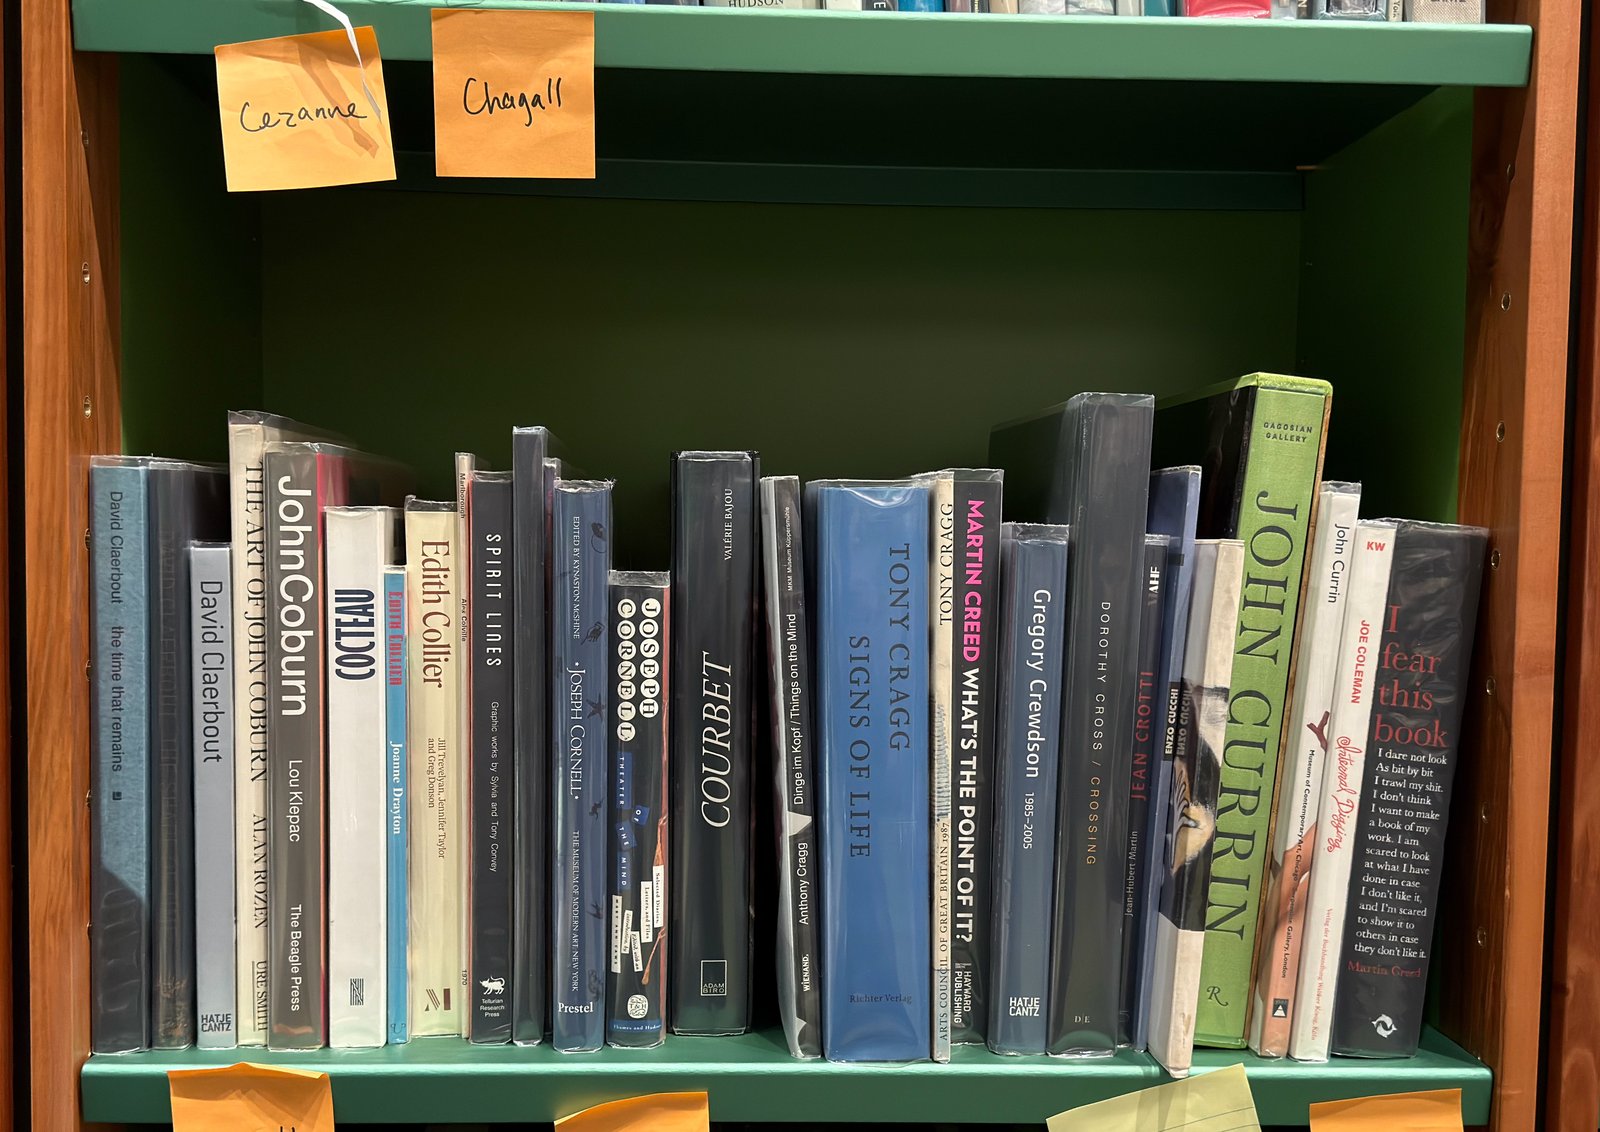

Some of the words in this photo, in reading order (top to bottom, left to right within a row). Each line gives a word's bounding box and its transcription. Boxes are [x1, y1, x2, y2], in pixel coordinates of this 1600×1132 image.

[239, 102, 368, 132] Cezanne
[464, 77, 562, 127] Chagall
[1263, 422, 1313, 434] GAGOSIAN
[1265, 432, 1307, 443] GALLERY
[245, 462, 265, 514] THE
[459, 473, 467, 518] Marlborough
[724, 488, 734, 519] BAJOU
[110, 491, 123, 530] David
[246, 520, 265, 573] ART
[723, 522, 733, 560] VALÉRIE
[940, 503, 952, 567] CRAGG
[964, 500, 985, 585] MARTIN
[1334, 523, 1350, 554] John
[1367, 541, 1386, 551] KW
[110, 535, 123, 604] Claerbout
[486, 534, 502, 599] SPIRIT
[573, 548, 580, 559] BY
[422, 540, 451, 605] Edith
[786, 576, 794, 591] MKM
[889, 543, 910, 631] TONY
[1236, 490, 1299, 665] JOHN
[1327, 560, 1345, 604] Currin
[247, 578, 265, 610] OF
[939, 573, 952, 626] TONY
[200, 581, 224, 644] David
[786, 614, 796, 641] Mind
[963, 591, 982, 662] CREED
[1026, 589, 1052, 671] Gregory
[1385, 605, 1401, 633] I
[110, 626, 124, 650] the
[244, 611, 265, 676] JOHN
[335, 589, 375, 680] COCTEAU
[1096, 602, 1111, 682] DOROTHY
[1359, 619, 1370, 643] JOE
[422, 611, 451, 689] Collier
[641, 600, 659, 717] JOSEPH
[788, 644, 797, 661] the
[1381, 642, 1441, 674] fear
[110, 653, 124, 683] time
[619, 601, 634, 738] CORNELL
[790, 664, 799, 678] on
[849, 636, 870, 729] SIGNS
[1350, 646, 1367, 704] COLEMAN
[110, 686, 124, 711] that
[200, 652, 224, 763] Claerbout
[567, 668, 586, 721] JOSEPH
[789, 681, 801, 718] Things
[889, 643, 910, 752] CRAGG
[1136, 671, 1153, 742] CROTTI
[1168, 688, 1179, 723] CUCCHI
[1378, 679, 1433, 710] this
[248, 681, 267, 783] COBURN
[490, 701, 500, 732] Graphic
[1025, 679, 1047, 778] Crewdson
[1092, 694, 1106, 750] CROSS
[1375, 714, 1448, 748] book
[110, 717, 124, 772] remains
[428, 738, 436, 754] and
[437, 737, 446, 751] Jill
[491, 736, 499, 758] works
[701, 650, 732, 828] COURBET
[791, 727, 803, 753] Kopf
[1165, 727, 1175, 754] ENZO
[289, 760, 303, 787] Lou
[390, 741, 403, 784] Joanne
[426, 755, 436, 776] Greg
[437, 752, 446, 796] Trevelyan,
[490, 762, 499, 772] by
[570, 724, 586, 796] CORNELL
[791, 756, 802, 769] im
[849, 739, 870, 779] OF
[1305, 749, 1315, 778] Museum
[1335, 736, 1363, 795] Internal
[428, 777, 436, 809] Donson
[490, 776, 500, 798] Sylvia
[792, 772, 806, 805] Dinge
[959, 756, 977, 799] THE
[1131, 753, 1148, 801] JEAN
[287, 791, 303, 842] Klepac
[390, 788, 403, 835] Drayton
[437, 797, 446, 832] Jennifer
[491, 802, 499, 816] and
[849, 791, 870, 858] LIFE
[1086, 776, 1100, 864] CROSSING
[1205, 690, 1272, 940] CURRIN
[1296, 788, 1310, 839] Contemporary
[253, 813, 267, 864] ALAN
[437, 833, 446, 859] Taylor
[490, 820, 499, 839] Tony
[572, 830, 580, 847] THE
[619, 827, 629, 846] THE
[941, 822, 950, 842] 1987
[957, 805, 976, 873] POINT
[1127, 831, 1138, 860] Martin
[1295, 839, 1304, 853] Art,
[490, 843, 499, 872] Convey
[572, 848, 580, 883] MUSEUM
[796, 842, 808, 877] Cragg
[939, 846, 948, 891] BRITAIN
[1292, 855, 1302, 882] Chicago
[253, 870, 267, 930] ROZEN
[572, 884, 580, 895] OF
[797, 879, 810, 925] Anthony
[956, 877, 974, 907] OF
[1124, 863, 1136, 917] Jean-Hubert
[290, 904, 302, 928] The
[572, 897, 580, 932] MODERN
[939, 896, 948, 934] GREAT
[955, 913, 974, 943] IT?
[288, 931, 302, 974] Beagle
[939, 937, 948, 952] OF
[1283, 926, 1293, 952] Gallery,
[256, 960, 268, 988] URE
[571, 951, 579, 970] NEW
[1281, 953, 1289, 979] London
[1347, 960, 1388, 975] Martin
[1391, 965, 1422, 978] Creed
[290, 976, 302, 1012] Press
[571, 971, 579, 991] YORK
[939, 956, 948, 1009] COUNCIL
[954, 971, 963, 1024] PUBLISHING
[963, 971, 972, 1012] HAYWARD
[256, 992, 268, 1032] SMITH
[558, 1001, 594, 1013] Prestel
[849, 994, 882, 1003] Richter
[885, 994, 912, 1005] Verlag
[1009, 997, 1040, 1007] HATJE
[1009, 1007, 1039, 1016] CANTZ
[201, 1015, 232, 1023] HATJE
[201, 1023, 232, 1032] CANTZ
[939, 1013, 948, 1041] ARTS
